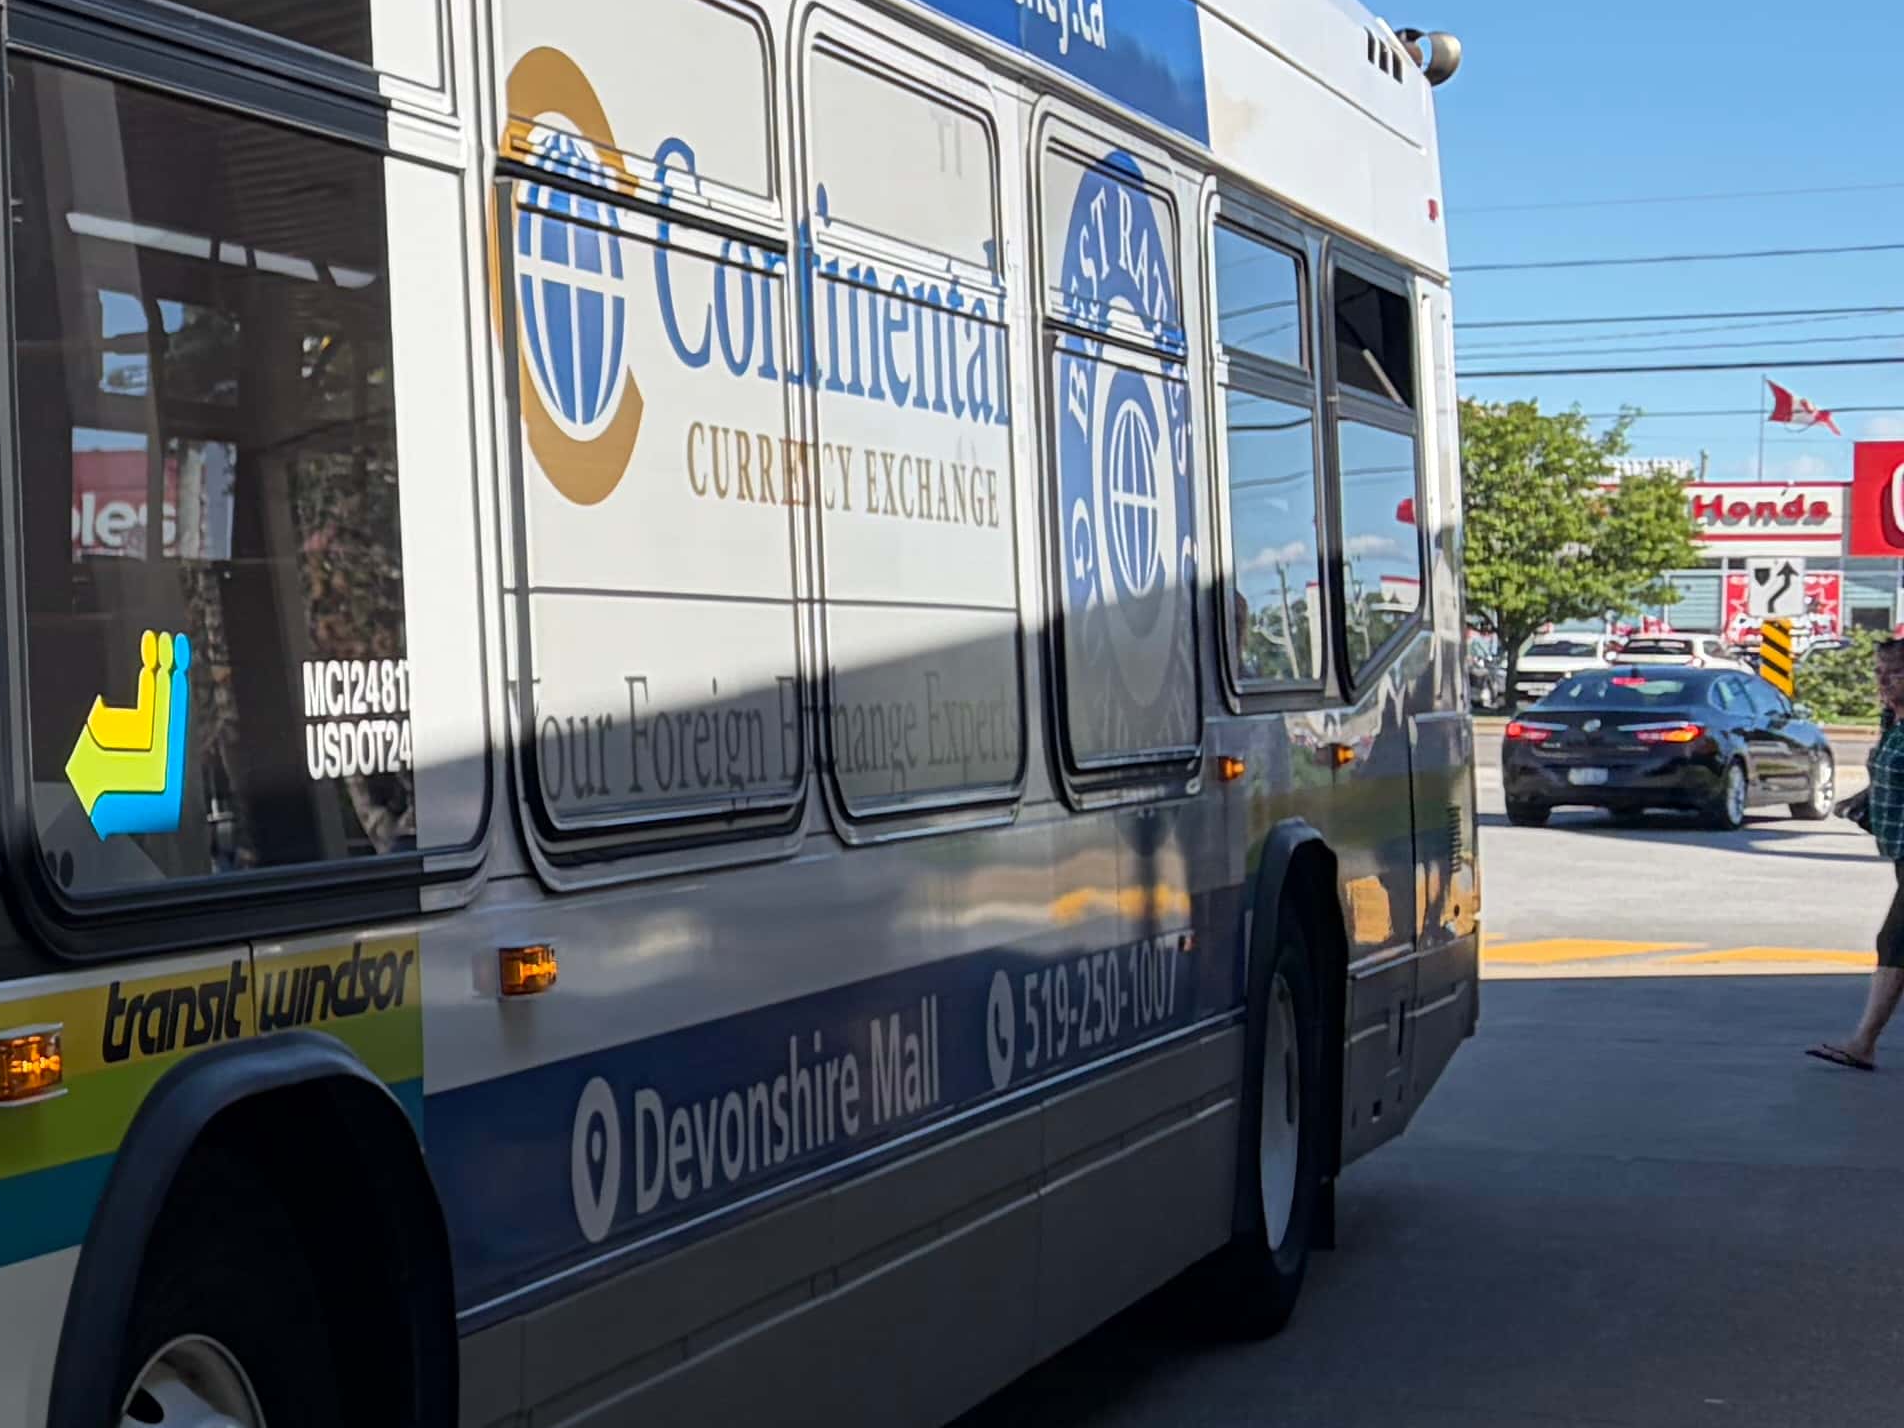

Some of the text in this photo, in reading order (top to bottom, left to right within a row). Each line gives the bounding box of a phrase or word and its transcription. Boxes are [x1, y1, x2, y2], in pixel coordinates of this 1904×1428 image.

[864, 449, 1000, 528] EXCHANGE
[1693, 493, 1832, 521] Honda
[625, 676, 768, 794] Foreign
[775, 667, 917, 787] Ehange
[103, 941, 414, 1063] transit windsor
[1024, 938, 1179, 1068] 519-250-1007
[634, 994, 940, 1214] Devonshire Mall
